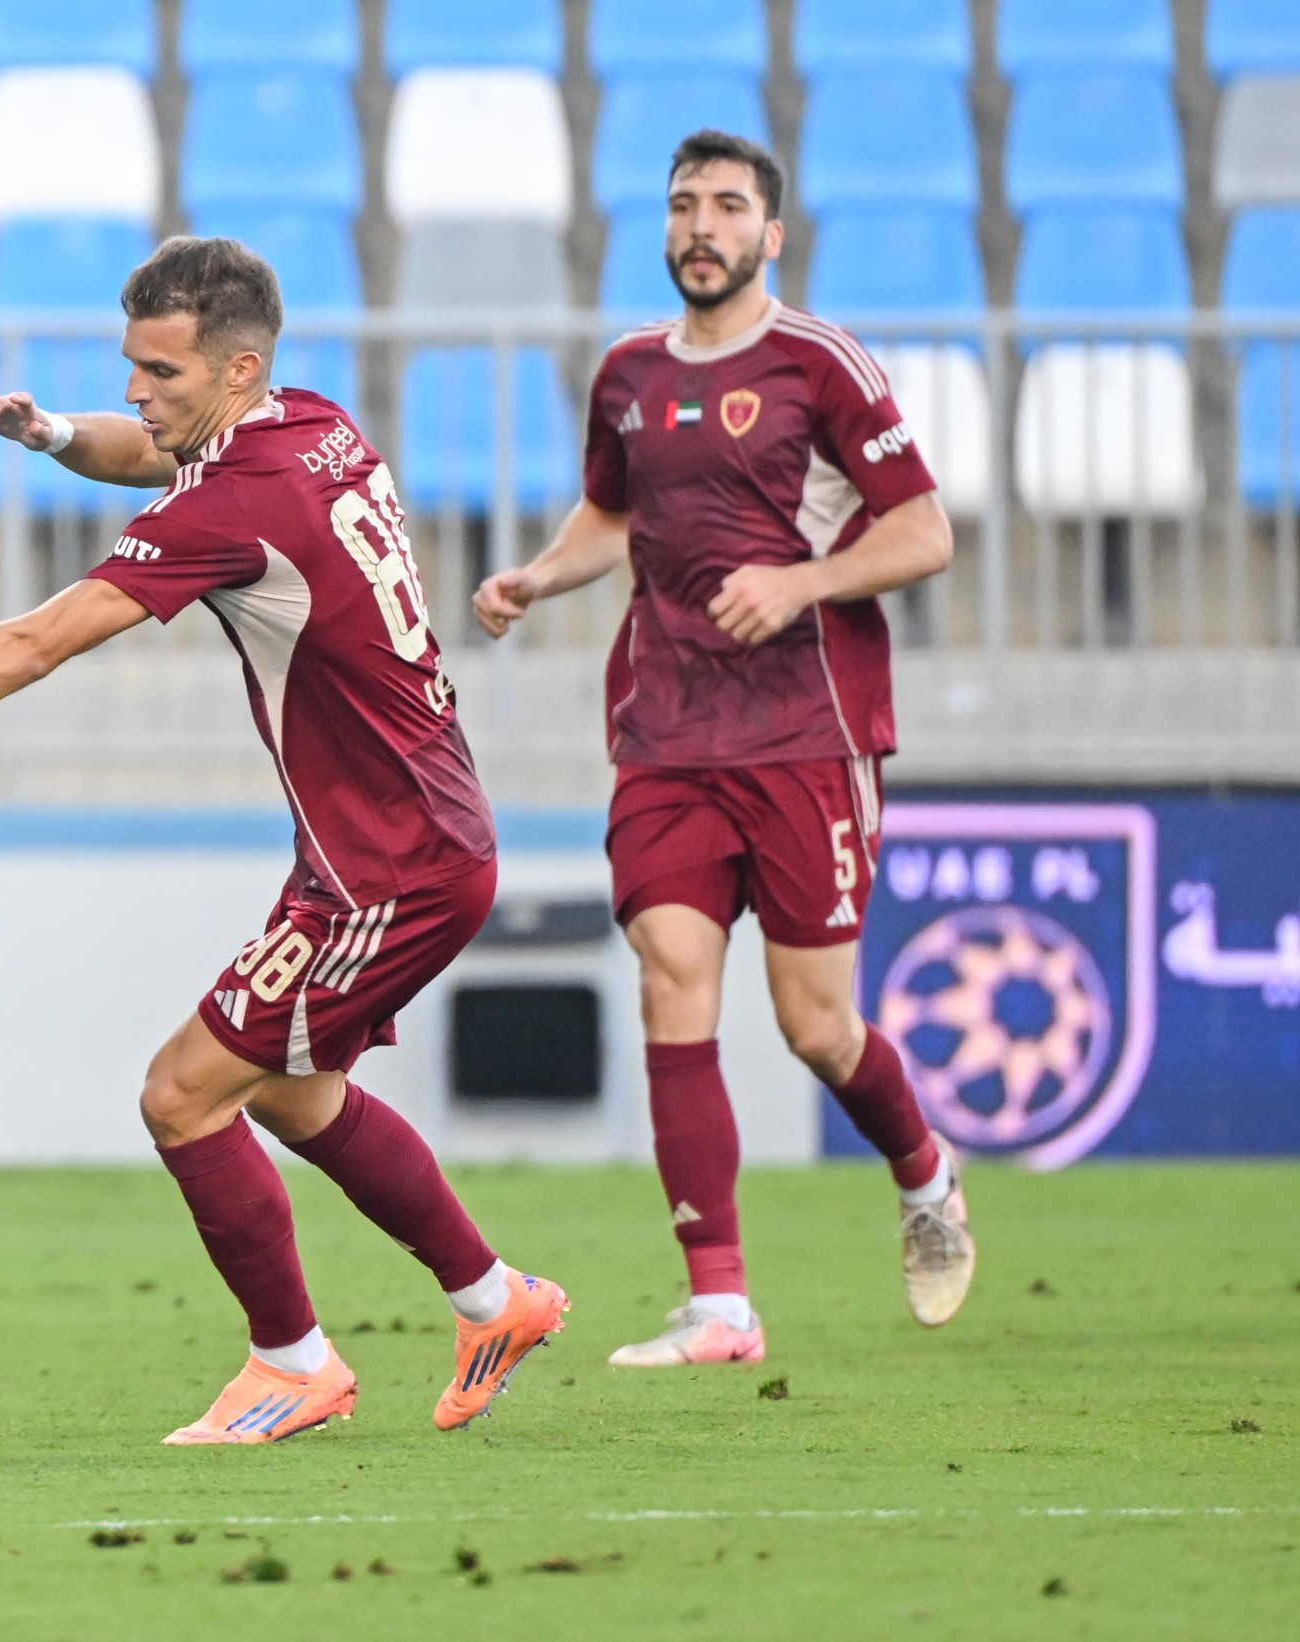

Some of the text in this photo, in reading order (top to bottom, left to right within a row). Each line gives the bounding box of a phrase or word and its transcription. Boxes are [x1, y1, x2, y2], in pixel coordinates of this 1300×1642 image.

[294, 417, 356, 473] burjeel
[831, 819, 858, 891] 5
[887, 846, 1013, 901] UAE
